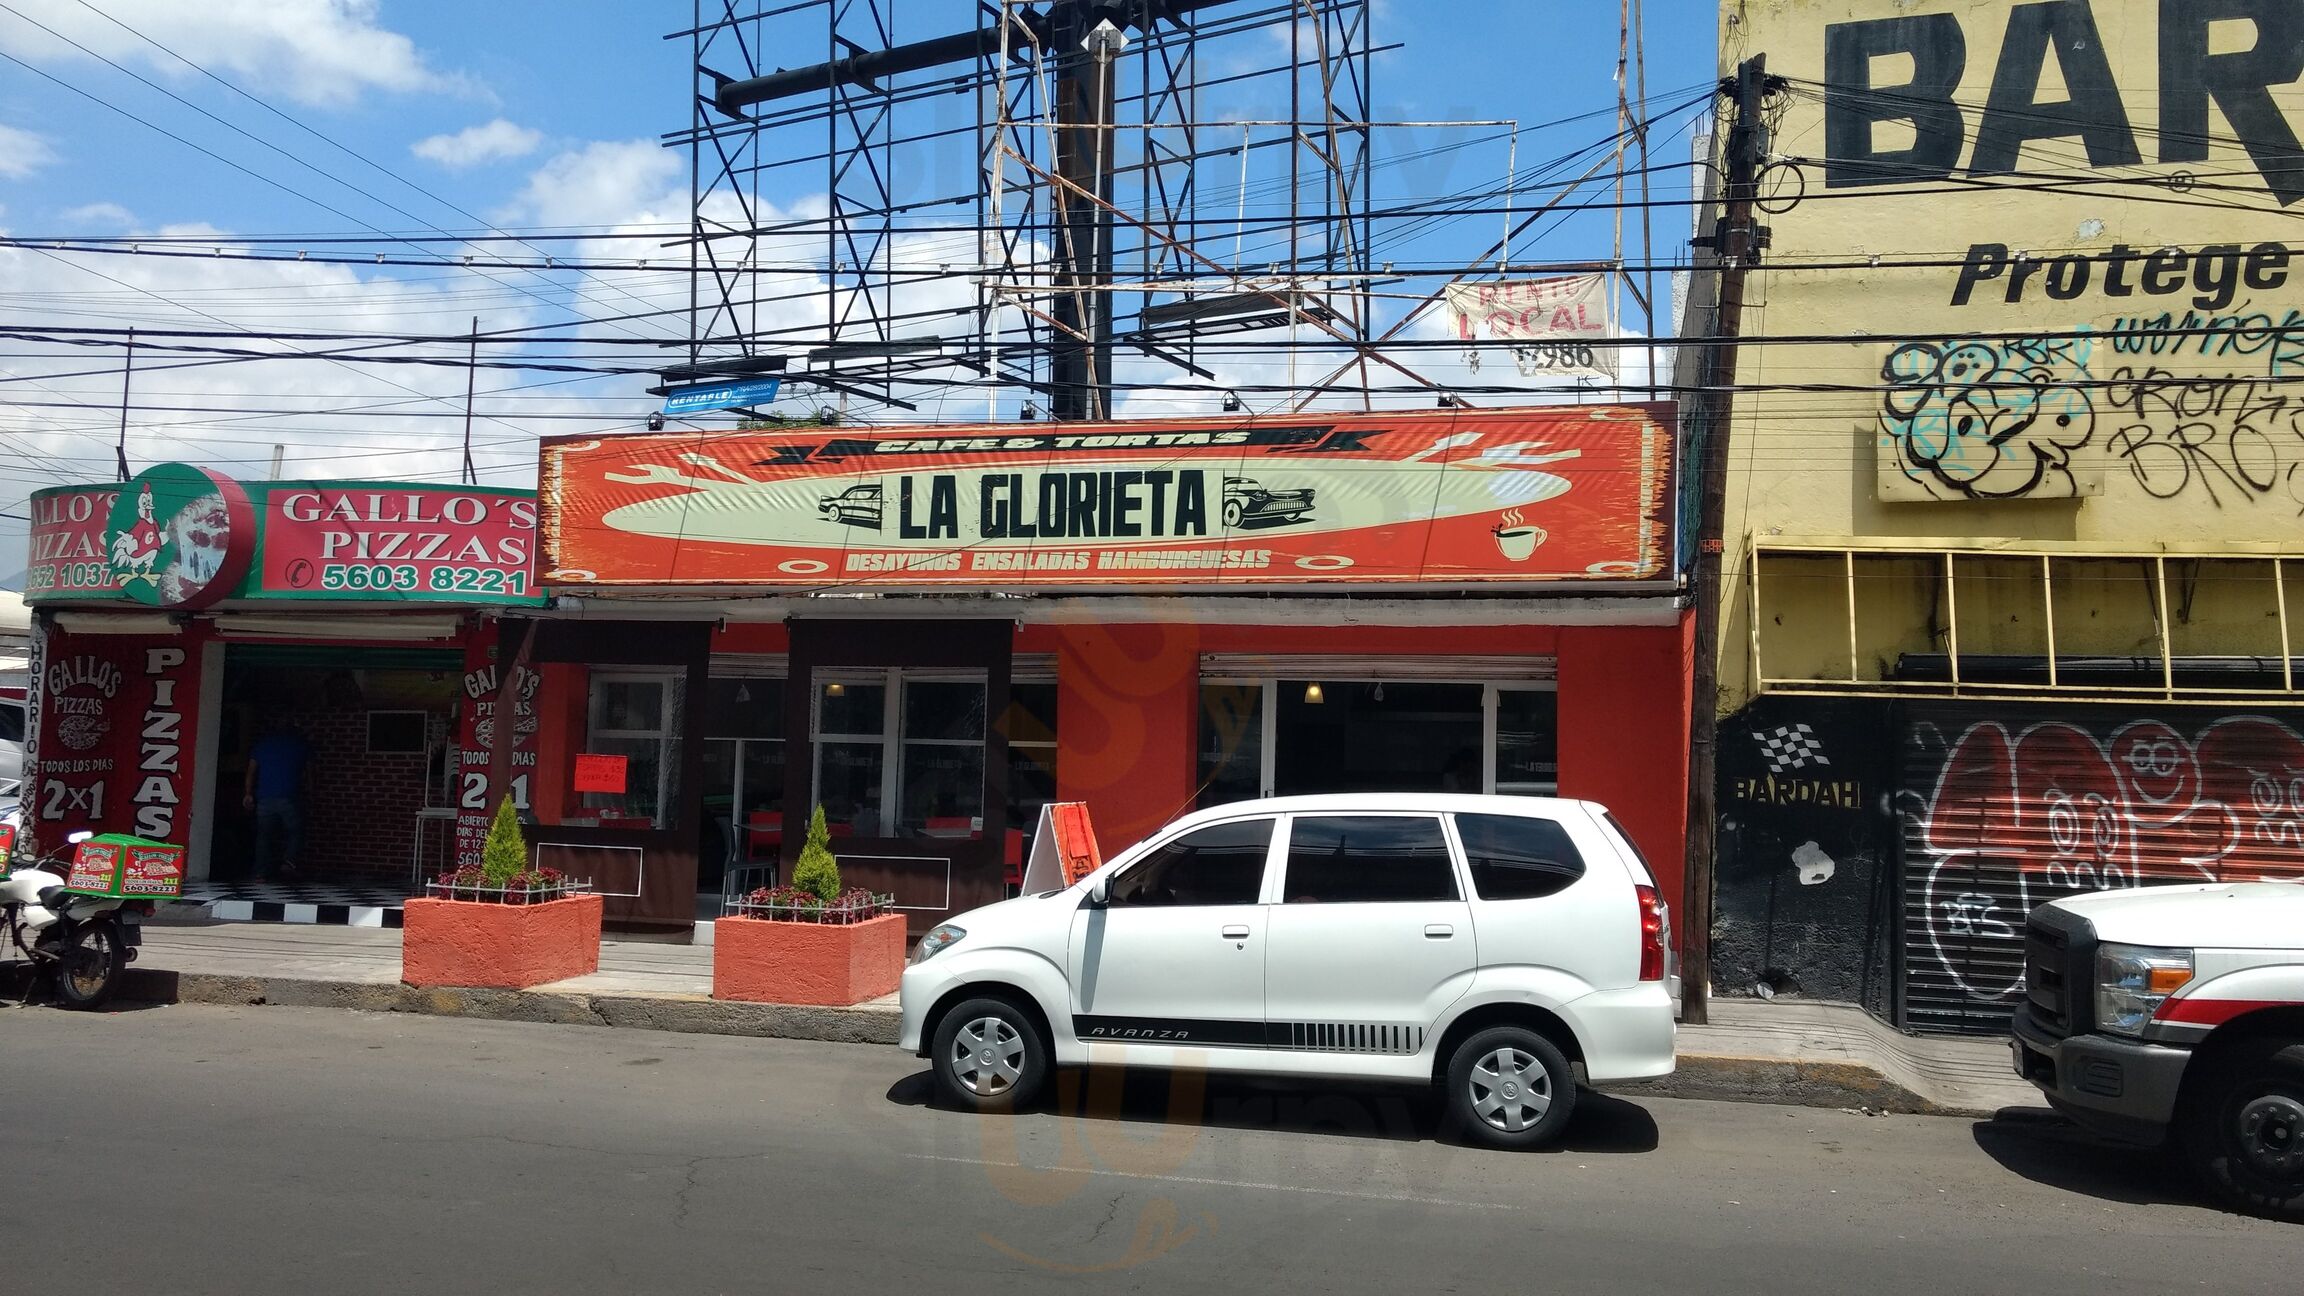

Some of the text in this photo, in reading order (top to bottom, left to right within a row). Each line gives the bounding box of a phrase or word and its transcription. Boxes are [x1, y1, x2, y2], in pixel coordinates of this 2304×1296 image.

[1950, 241, 2290, 310] Protege
[1460, 304, 1605, 340] LOCAL
[671, 390, 730, 405] RENTABLE
[1055, 431, 1252, 449] TORTAS
[900, 469, 1207, 539] LA GLORIETA
[318, 531, 528, 565] PIZZAS
[845, 549, 1272, 572] DESAYUNOS ENSALADAS HAMBURGUESAS
[321, 563, 527, 595] 5603 8221
[48, 655, 122, 698] GALLO'S
[28, 645, 43, 754] HORARIO
[53, 696, 104, 715] PIZZAS
[133, 648, 186, 839] PIZZAS
[40, 759, 71, 773] TODOS
[73, 759, 90, 772] LOS
[461, 751, 536, 766] TODOS DIAS
[124, 884, 178, 894] 5603-8221
[1091, 1027, 1189, 1039] AVANZA
